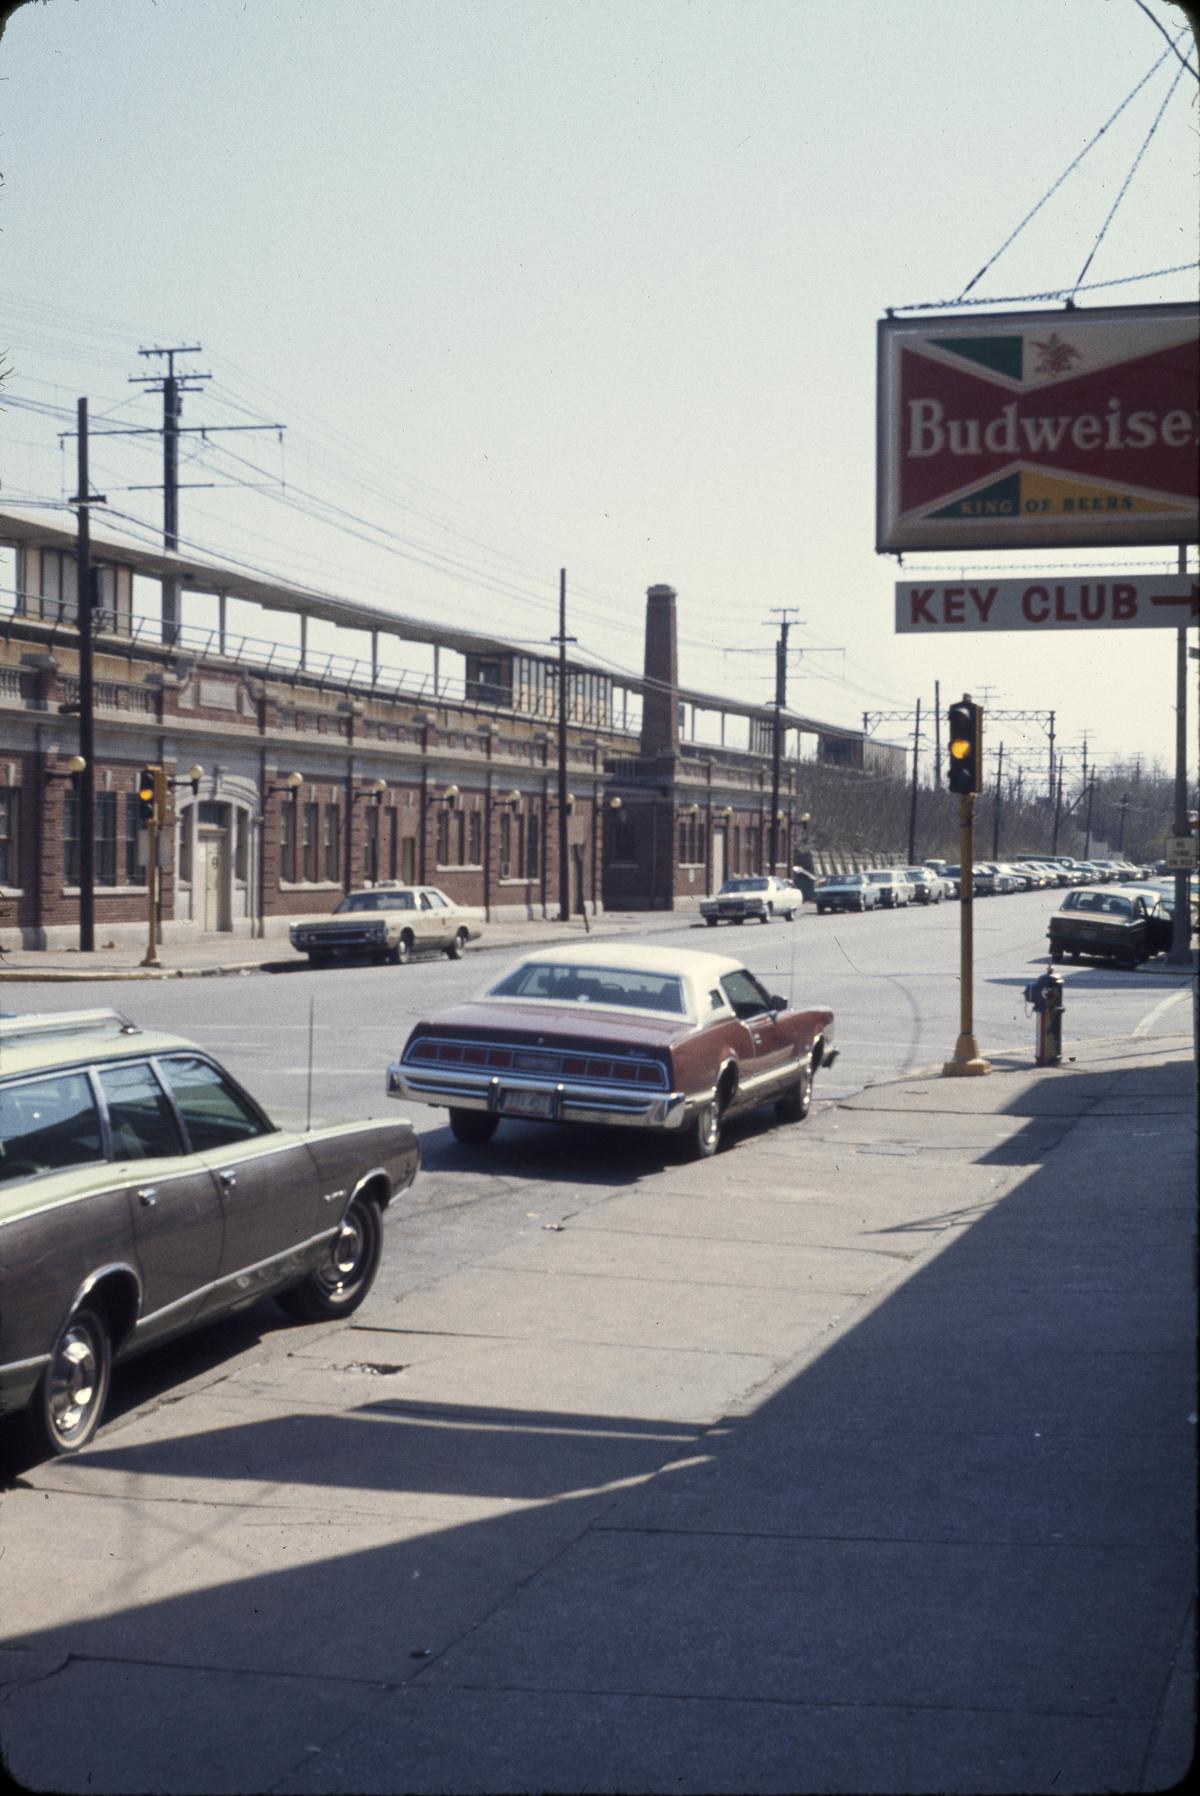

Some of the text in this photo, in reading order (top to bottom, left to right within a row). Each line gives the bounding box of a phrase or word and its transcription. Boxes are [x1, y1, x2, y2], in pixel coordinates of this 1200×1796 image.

[907, 397, 1198, 457] Budweise
[959, 496, 1133, 515] KING OF BEERS
[910, 583, 1138, 624] KEY CLUB
